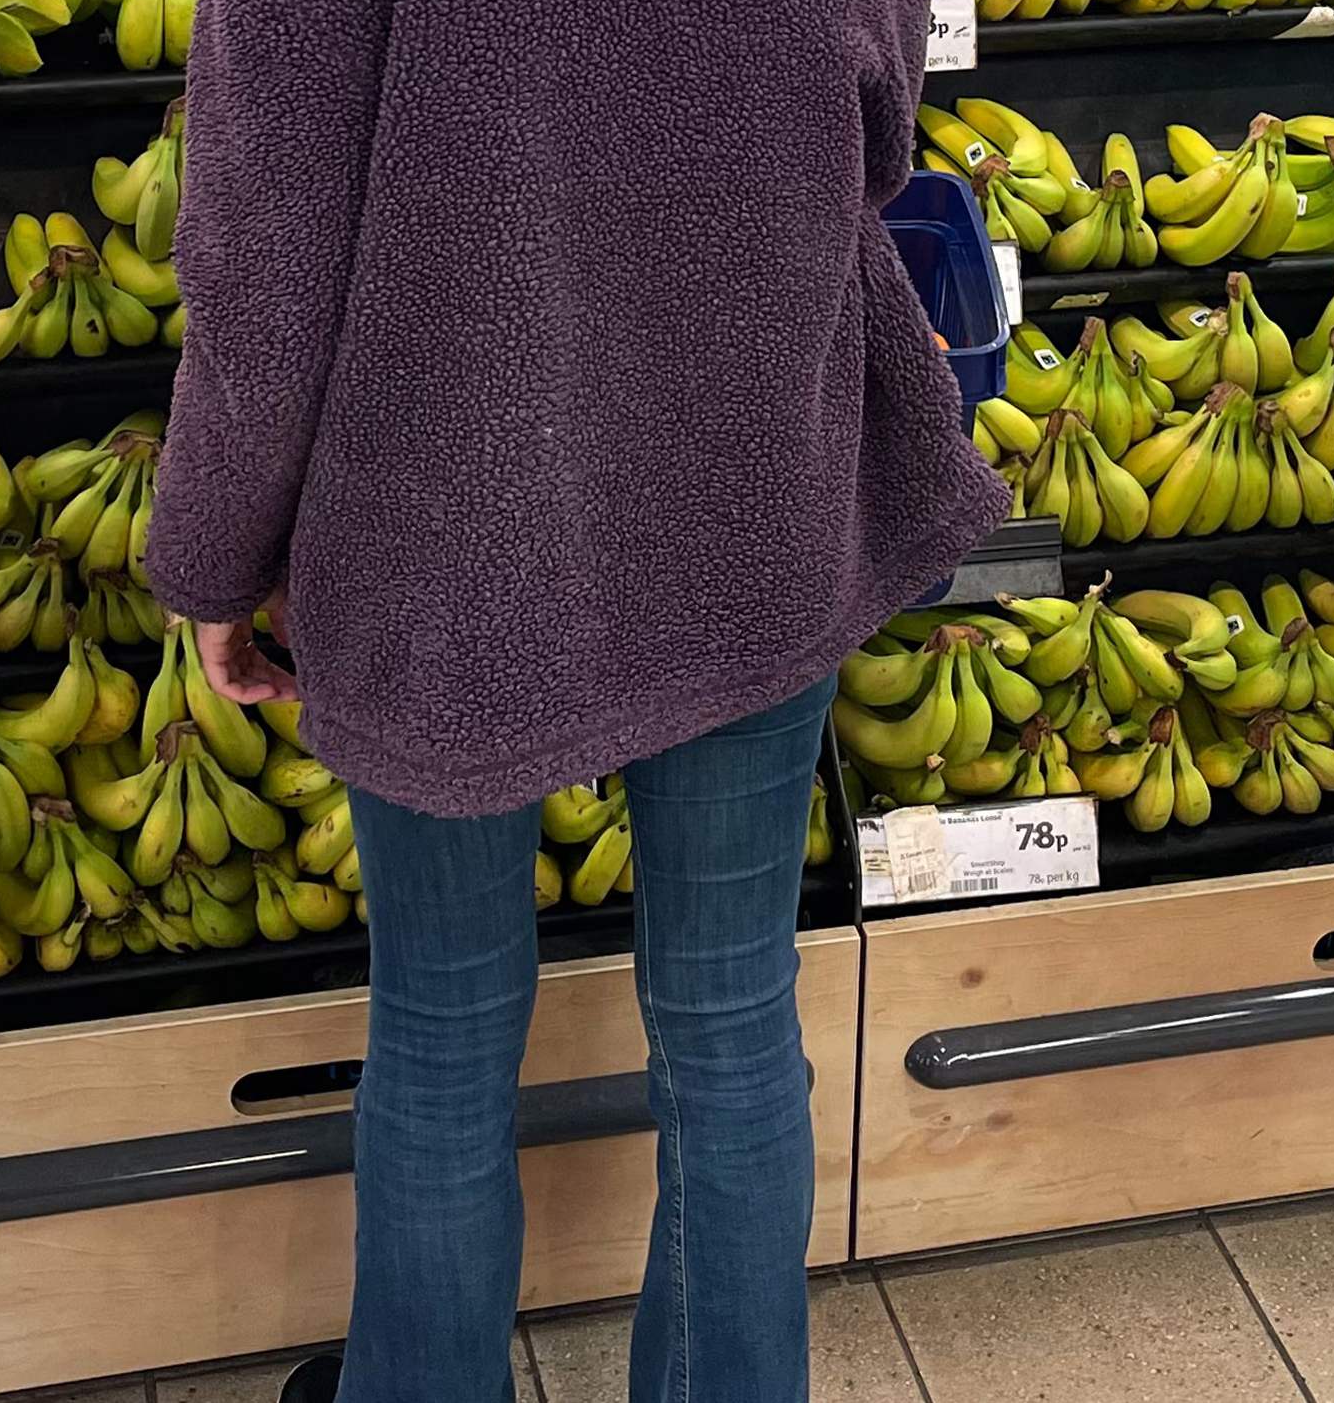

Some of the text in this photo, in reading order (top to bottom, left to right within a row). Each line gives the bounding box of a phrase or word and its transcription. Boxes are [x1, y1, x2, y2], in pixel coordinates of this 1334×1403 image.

[1016, 821, 1068, 851] 78p
[1047, 872, 1064, 883] per
[1066, 871, 1079, 882] kg
